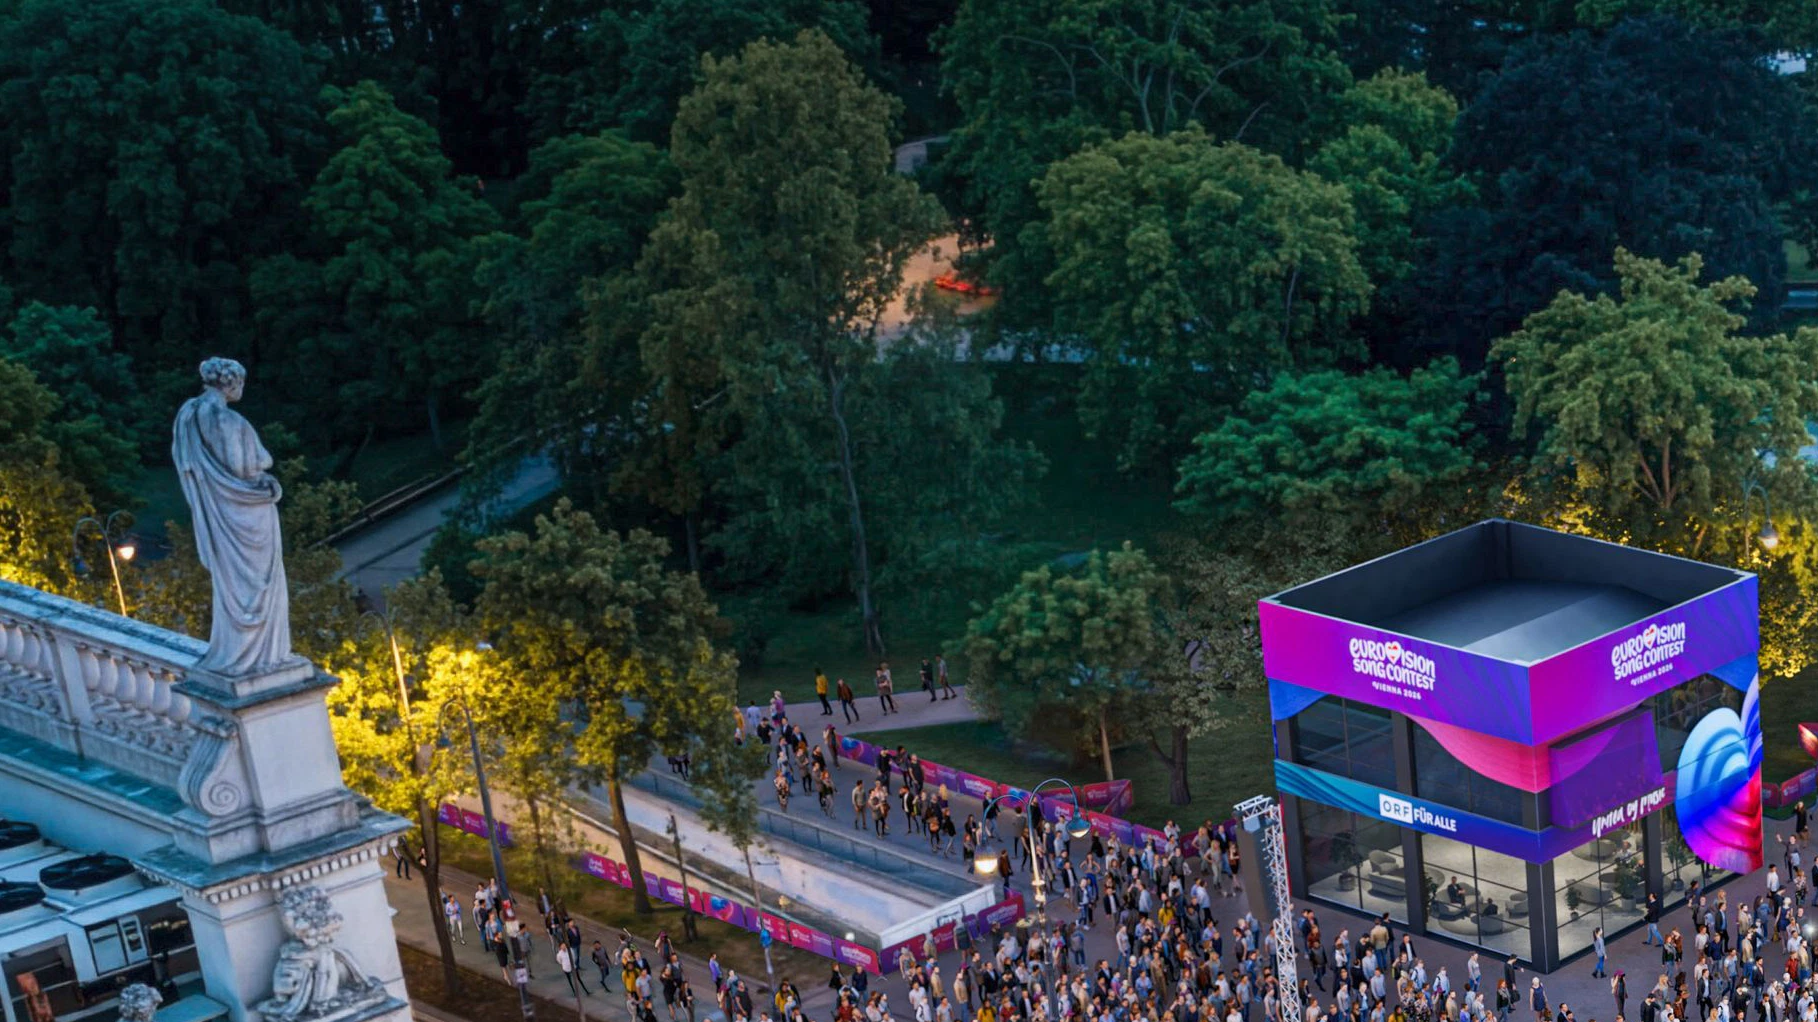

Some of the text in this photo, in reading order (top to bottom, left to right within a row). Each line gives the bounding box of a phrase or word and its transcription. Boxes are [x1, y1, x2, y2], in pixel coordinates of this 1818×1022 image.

[1643, 640, 1685, 668] CONTEST
[1386, 667, 1436, 691] CONTEST
[1382, 800, 1412, 822] ORF
